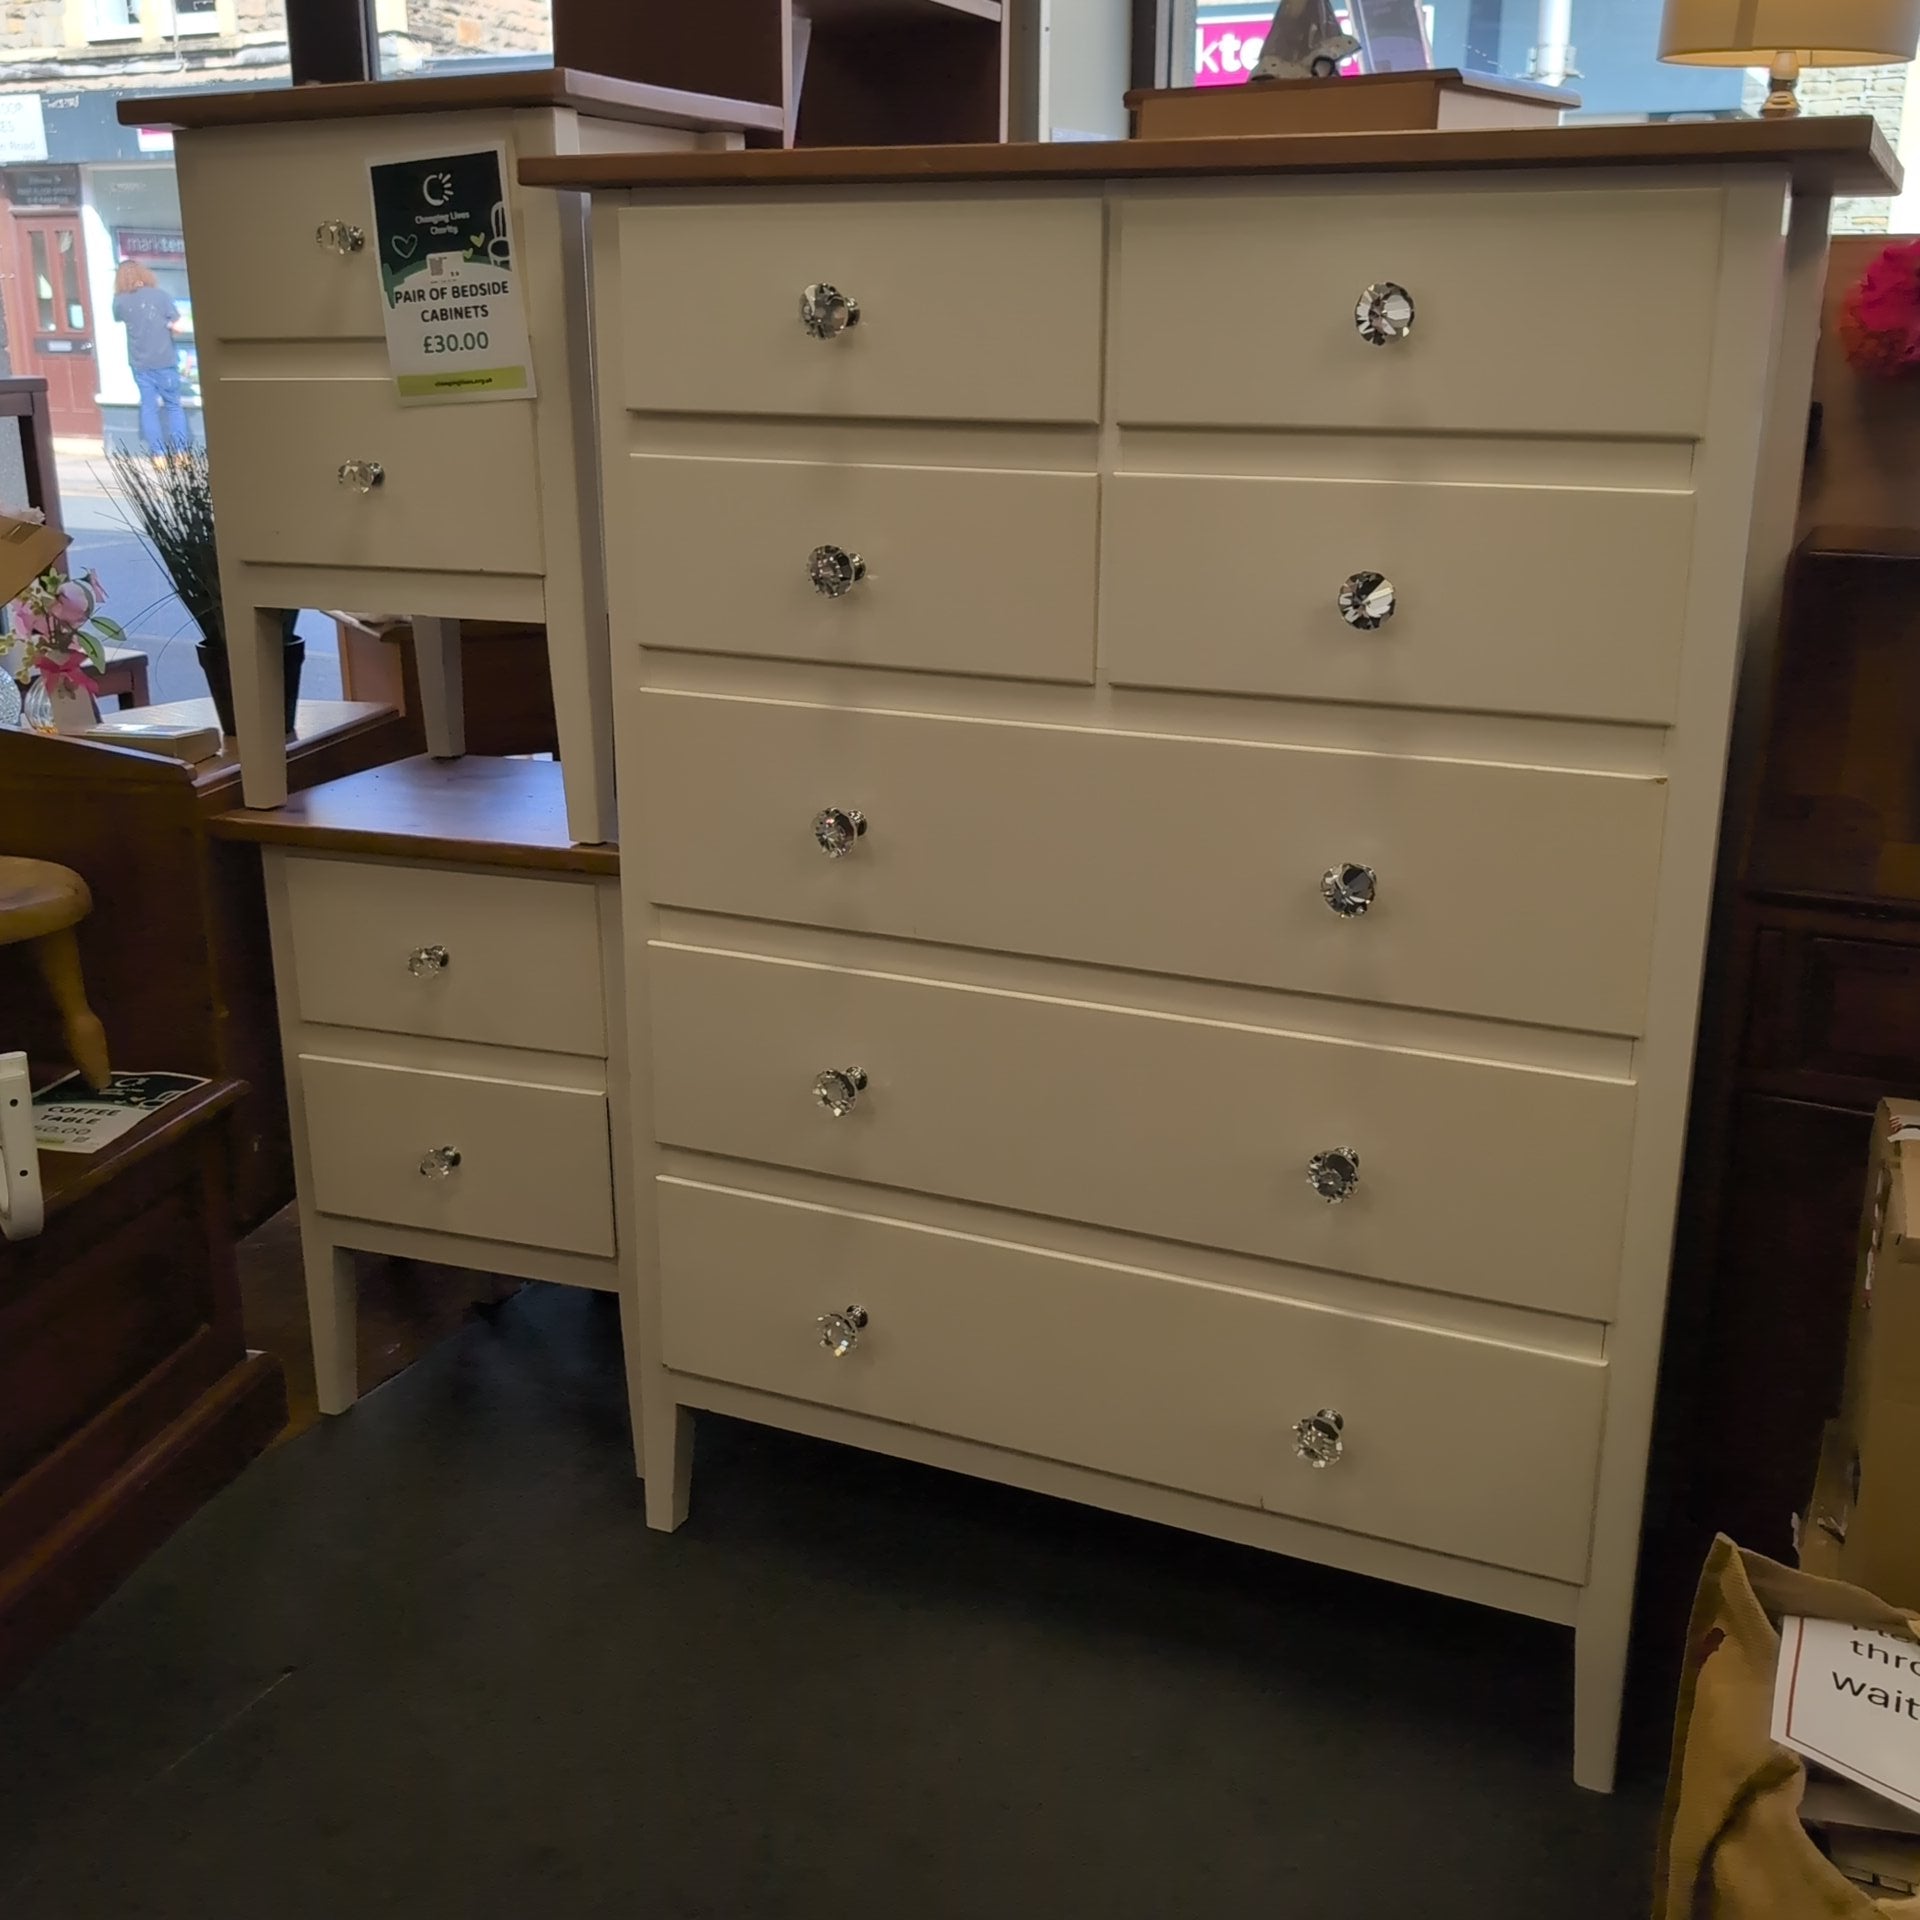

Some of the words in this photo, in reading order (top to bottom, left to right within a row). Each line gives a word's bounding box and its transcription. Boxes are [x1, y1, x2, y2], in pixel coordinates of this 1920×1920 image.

[394, 289, 426, 304] PAIR
[429, 287, 448, 301] OF
[451, 281, 509, 299] BEDSIDE
[421, 304, 489, 322] CABINETS
[423, 331, 489, 353] £30.00
[41, 1115, 101, 1124] TABLE
[48, 1106, 121, 1116] COFFEE
